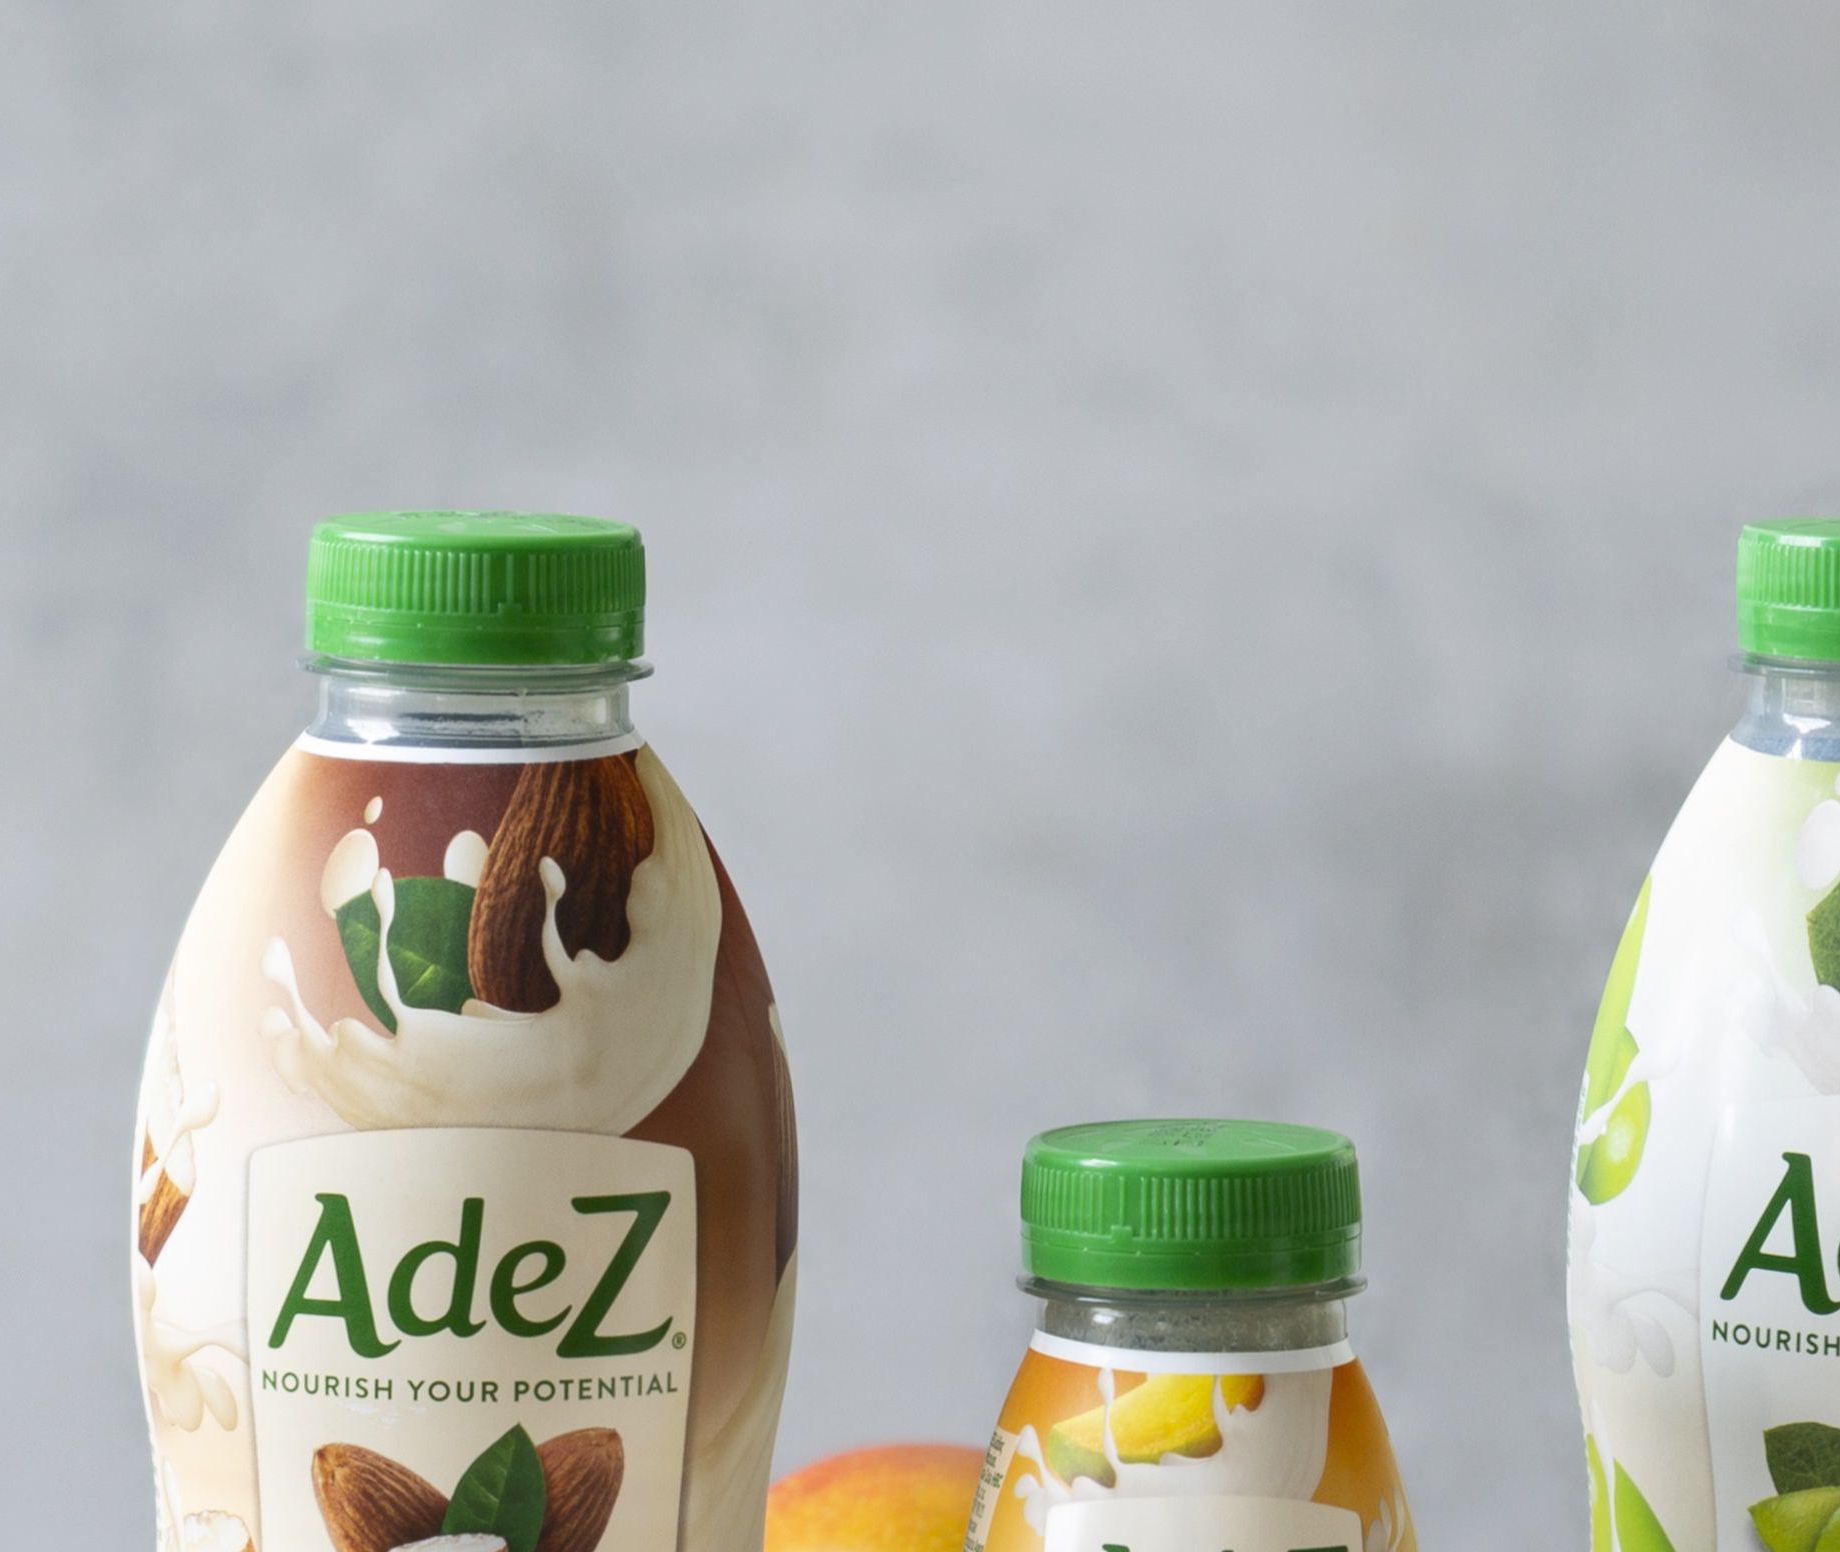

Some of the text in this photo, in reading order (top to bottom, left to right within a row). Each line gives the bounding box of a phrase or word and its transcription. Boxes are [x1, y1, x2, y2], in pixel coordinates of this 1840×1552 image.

[262, 1368, 679, 1403] NOURISH YOUR POTENTIAL
